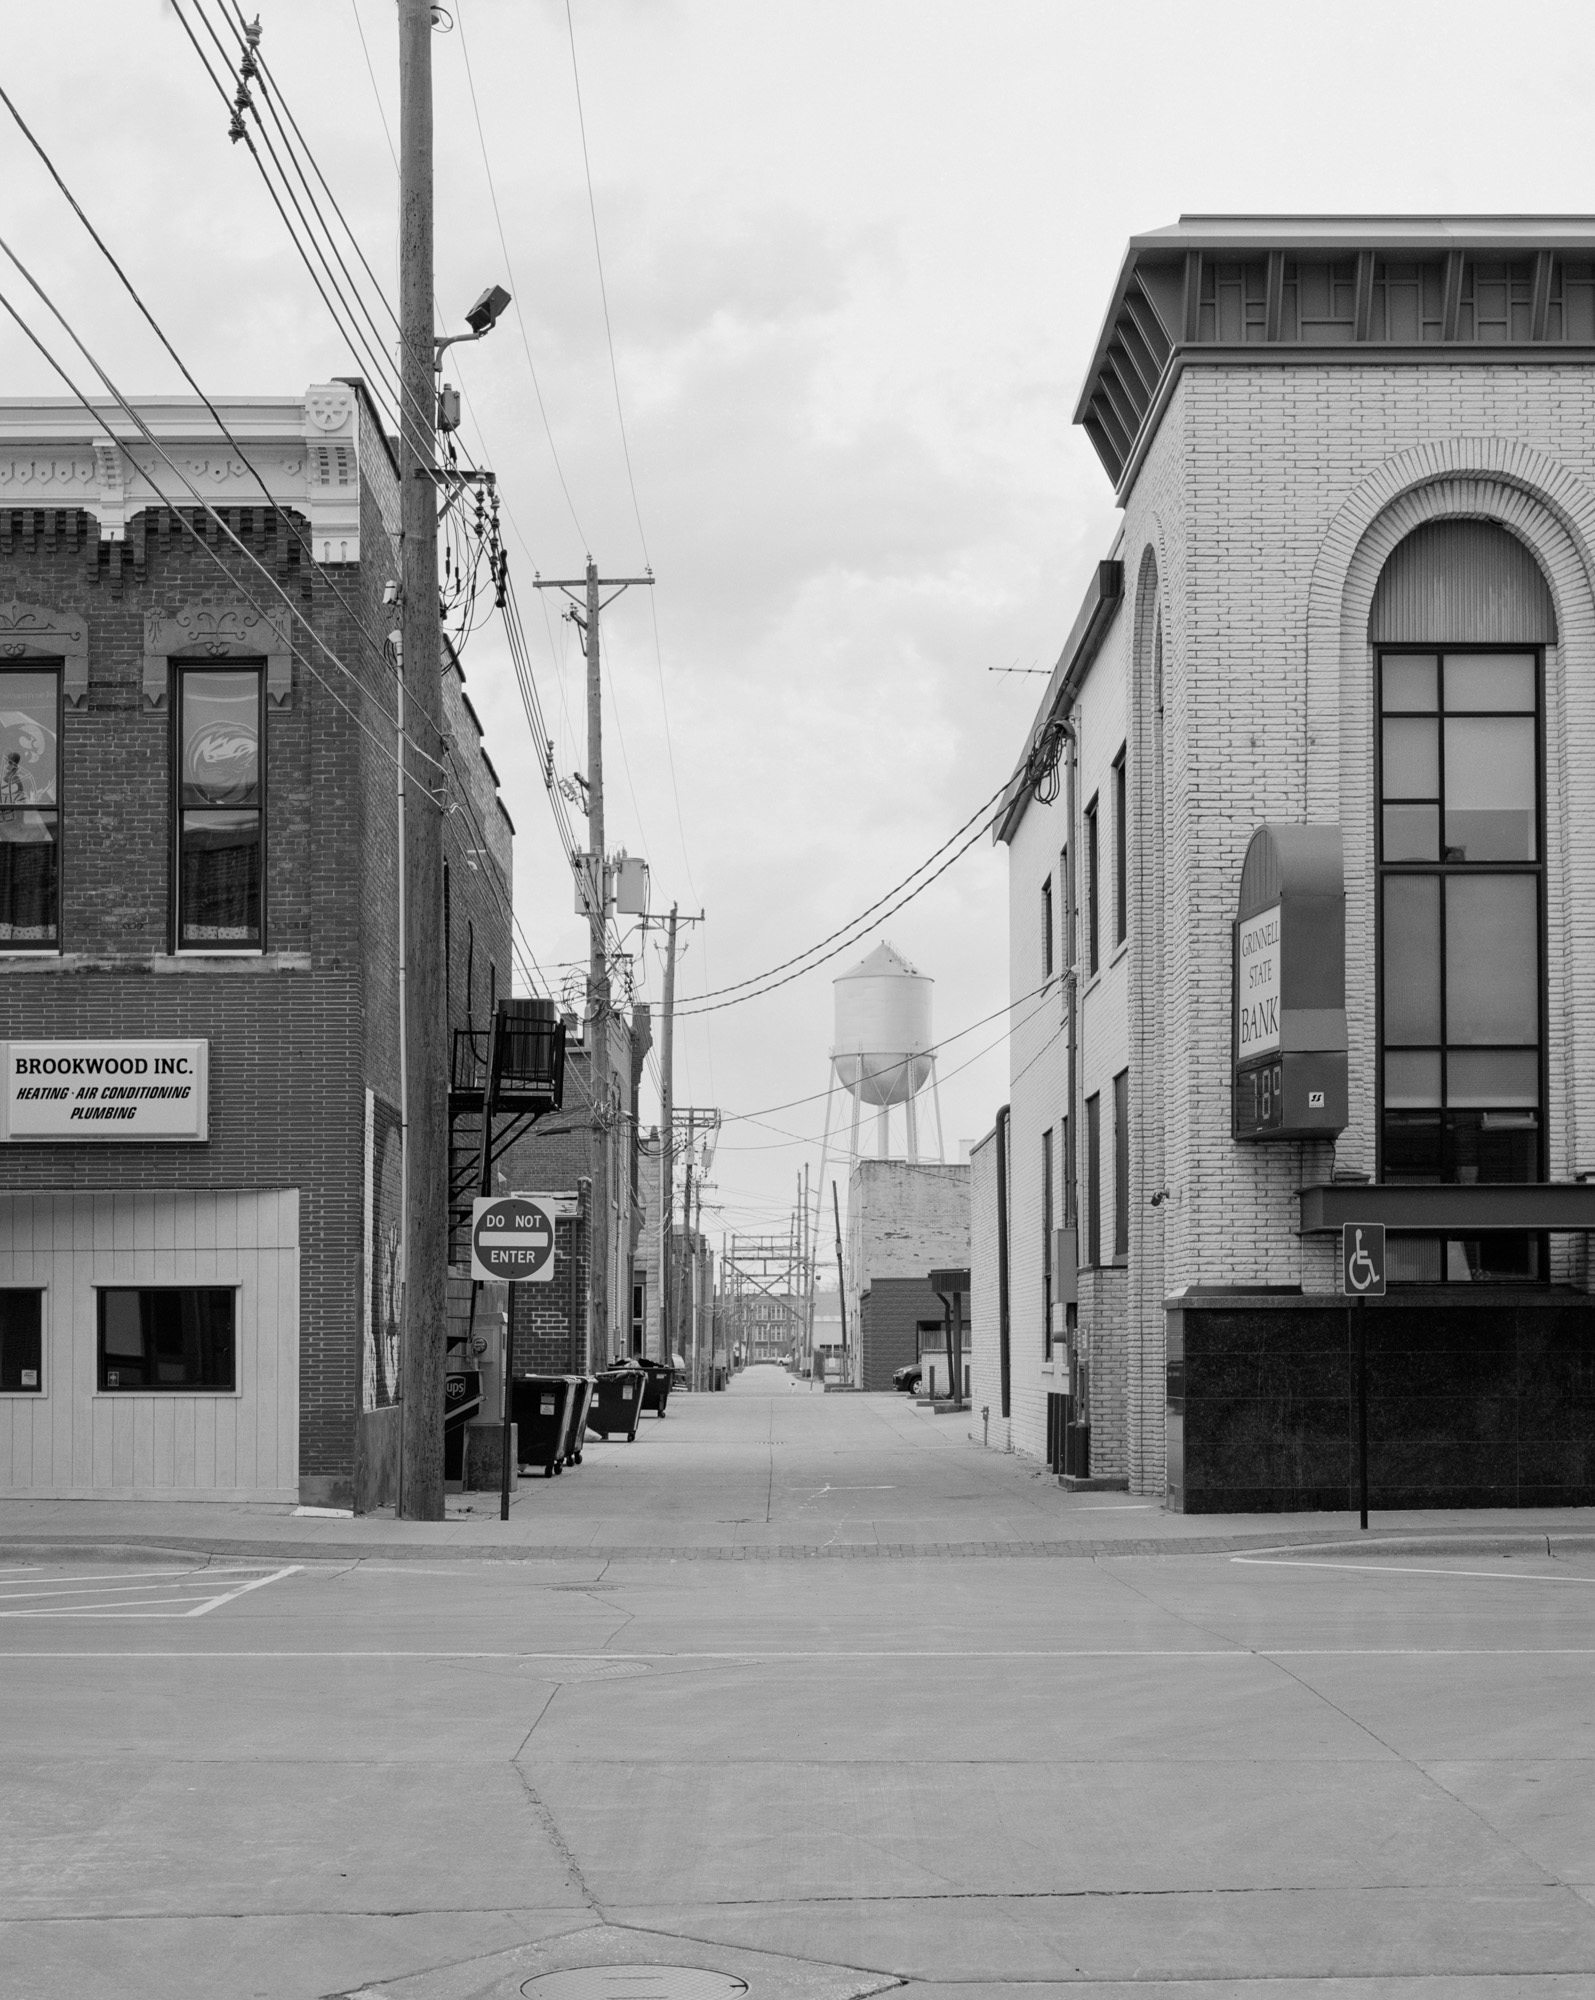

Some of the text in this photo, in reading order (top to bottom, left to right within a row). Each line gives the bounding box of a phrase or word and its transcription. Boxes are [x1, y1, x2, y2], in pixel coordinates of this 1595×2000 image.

[1241, 920, 1279, 957] GRINNELL
[1249, 959, 1272, 989] STATE
[1241, 995, 1278, 1044] BANK
[15, 1058, 194, 1074] BROOKWOOD INC.
[16, 1086, 191, 1100] HEATING AIR CONDITIONING
[70, 1107, 137, 1120] PLUMBING
[486, 1214, 542, 1228] DO NOT
[490, 1250, 536, 1263] ENTER
[446, 1382, 464, 1396] ups
